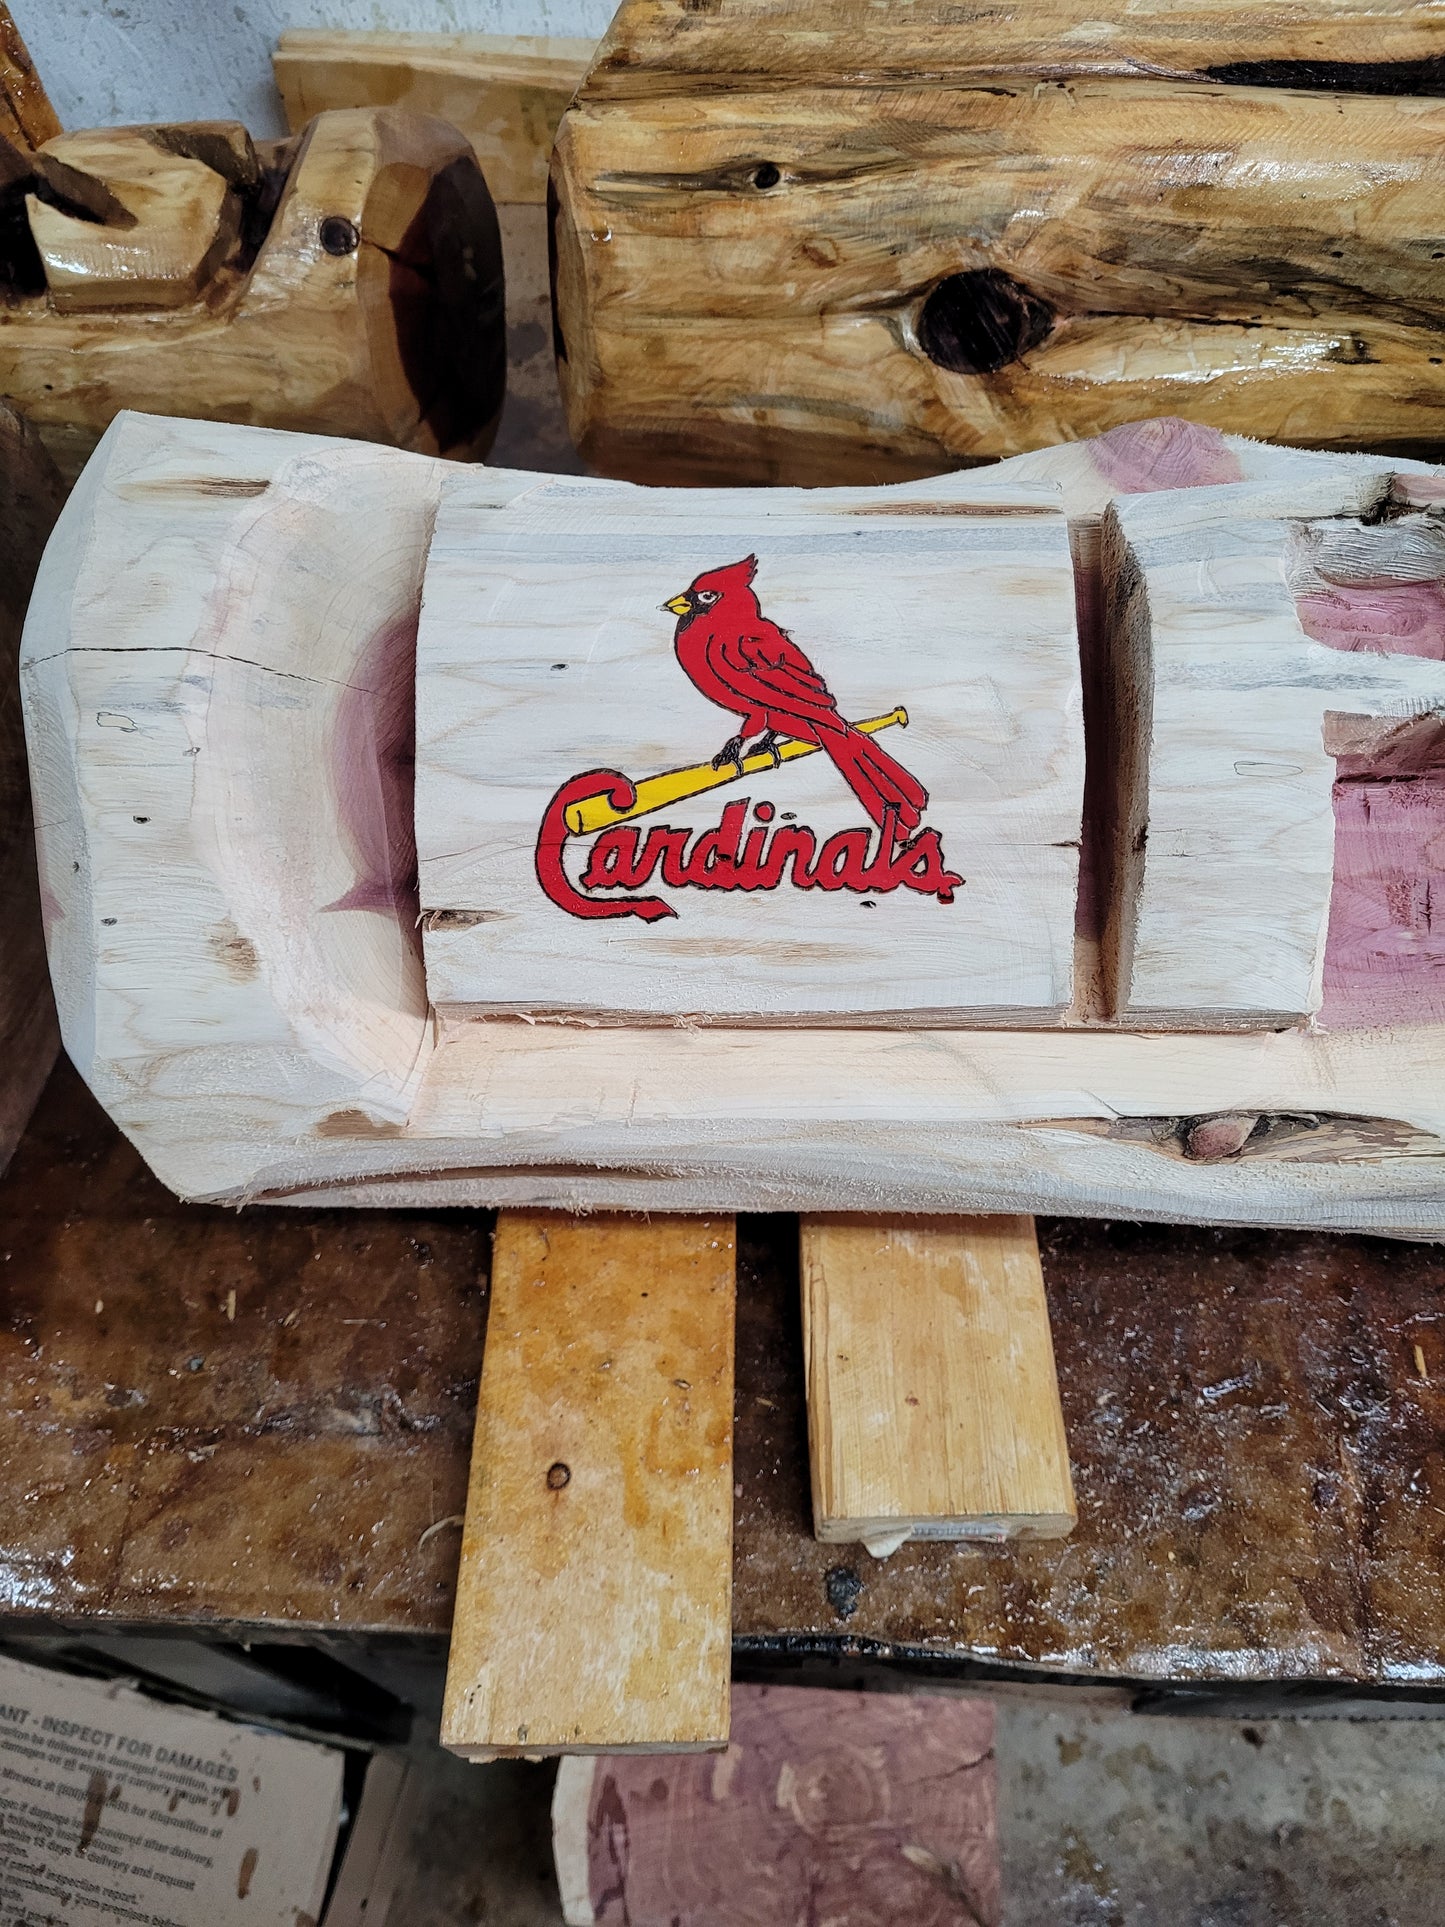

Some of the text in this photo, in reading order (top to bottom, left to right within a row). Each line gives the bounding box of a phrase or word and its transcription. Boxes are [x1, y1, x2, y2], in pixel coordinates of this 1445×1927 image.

[534, 767, 966, 923] Cardinals
[41, 1716, 113, 1747] INSPECT
[116, 1737, 152, 1758] FOR
[155, 1747, 238, 1782] DAMAGES
